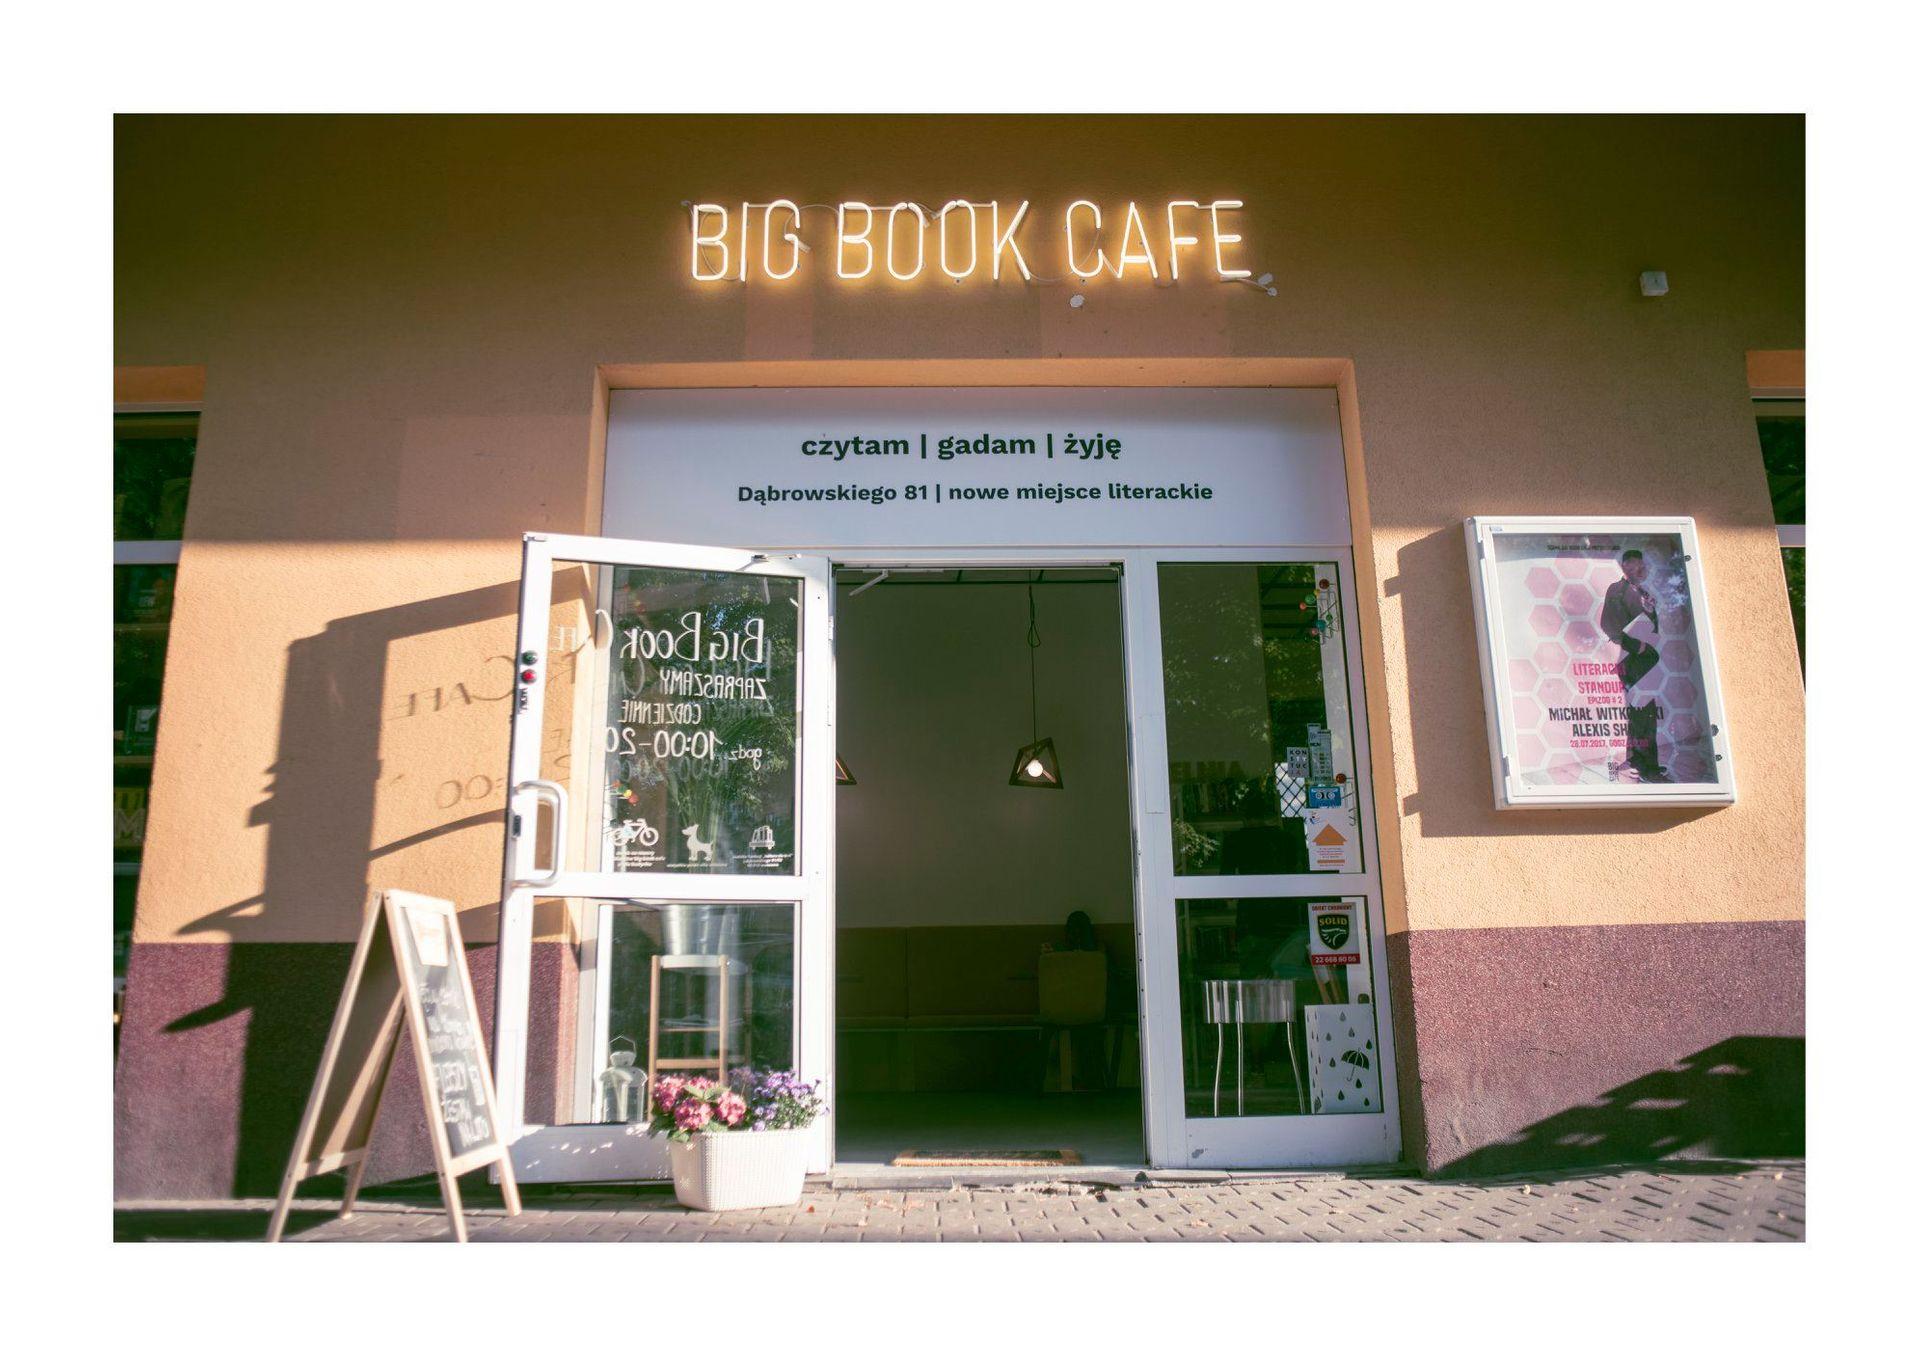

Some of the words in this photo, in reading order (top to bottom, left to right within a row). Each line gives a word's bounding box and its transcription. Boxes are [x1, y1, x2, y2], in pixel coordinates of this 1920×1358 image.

[691, 199, 802, 283] BIG
[836, 198, 1031, 282] BOOK
[1065, 199, 1253, 280] CAFE
[801, 434, 910, 462] czytam
[937, 433, 1036, 461] gadam
[1063, 432, 1122, 461] żyję
[737, 484, 898, 507] Dąbrowskiego
[904, 484, 928, 501] 81
[948, 487, 1010, 501] nowe
[1016, 482, 1102, 504] miejsce
[1107, 482, 1214, 501] literackie
[1596, 706, 1665, 720] WITKOKI
[1572, 723, 1611, 737] ALEXIS
[1318, 916, 1348, 926] SOLID
